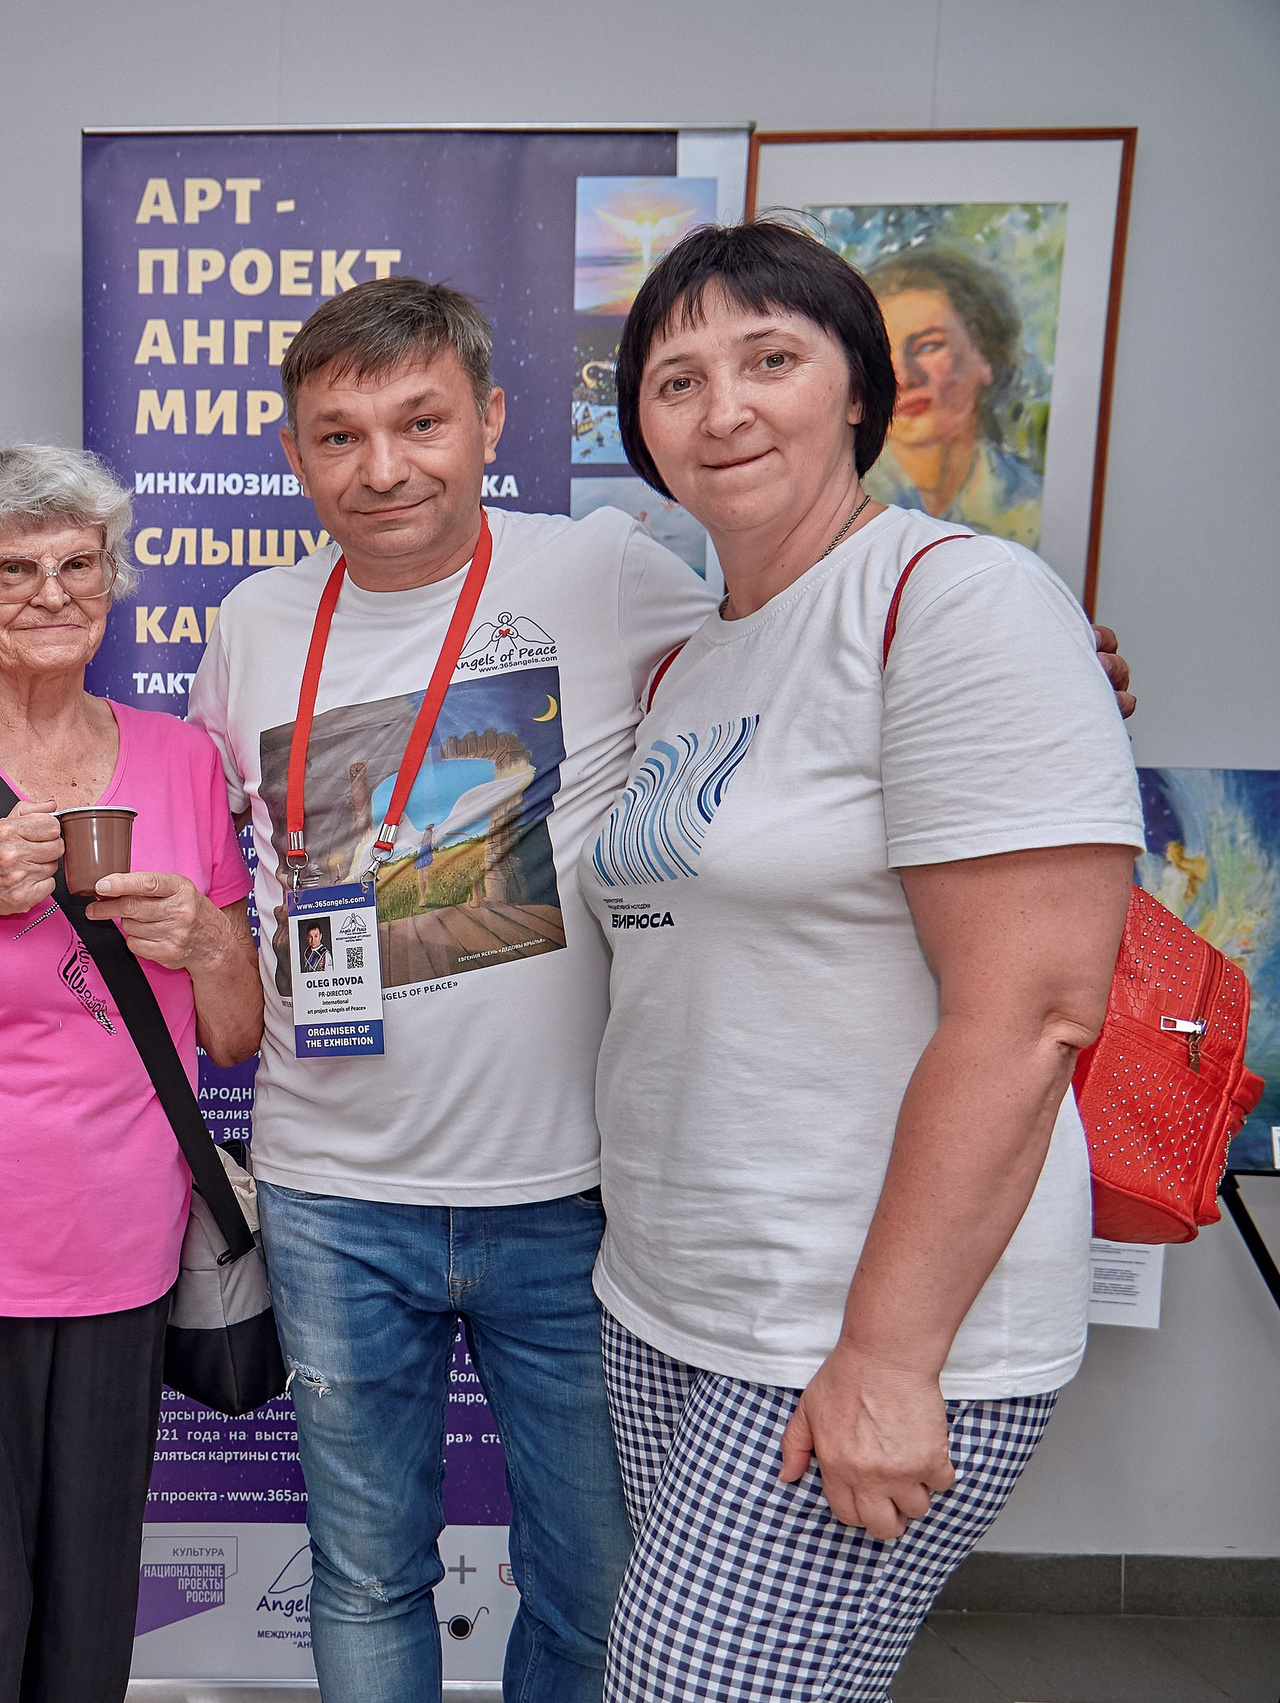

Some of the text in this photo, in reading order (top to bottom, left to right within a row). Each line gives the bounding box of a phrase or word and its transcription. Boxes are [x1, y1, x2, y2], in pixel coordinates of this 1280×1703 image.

[135, 177, 262, 225] АРТ
[138, 248, 402, 296] ПРОЕКТ
[134, 319, 304, 366] АНГЕ
[135, 389, 285, 436] МИР
[134, 472, 304, 497] ИНКЛЮЗИВ
[134, 527, 331, 567] СЛЫШУ
[500, 649, 514, 662] of
[519, 645, 557, 659] Peace
[478, 655, 558, 673] www.365angels.com
[296, 895, 366, 911] www.365angels.com
[611, 911, 675, 929] БИРЮСА
[306, 976, 364, 989] OLEG ROVDA
[409, 987, 421, 997] OF
[424, 980, 458, 994] PEACE»
[318, 989, 352, 998] PR-DIRECTOR
[322, 998, 349, 1006] International
[314, 1008, 328, 1016] project
[307, 1025, 370, 1037] ORGANISER OF
[305, 1036, 374, 1048] THE EXHIBITION
[199, 1087, 255, 1102] АРОДН
[200, 1110, 252, 1120] реализ
[223, 1128, 250, 1140] 365
[159, 1411, 194, 1423] урсы
[187, 1431, 220, 1443] года
[229, 1431, 246, 1441] на
[255, 1431, 298, 1441] выста
[208, 1451, 269, 1463] картины
[271, 1451, 278, 1461] с
[161, 1491, 218, 1503] проекта
[227, 1490, 309, 1502] www.365an
[172, 1547, 225, 1557] КУЛЬТУРА
[144, 1565, 224, 1579] НАЦИОНАЛЬНЫЕ
[178, 1578, 224, 1590] ПРОЕКТЫ
[186, 1590, 224, 1603] РОССИИ
[256, 1594, 310, 1617] Angel
